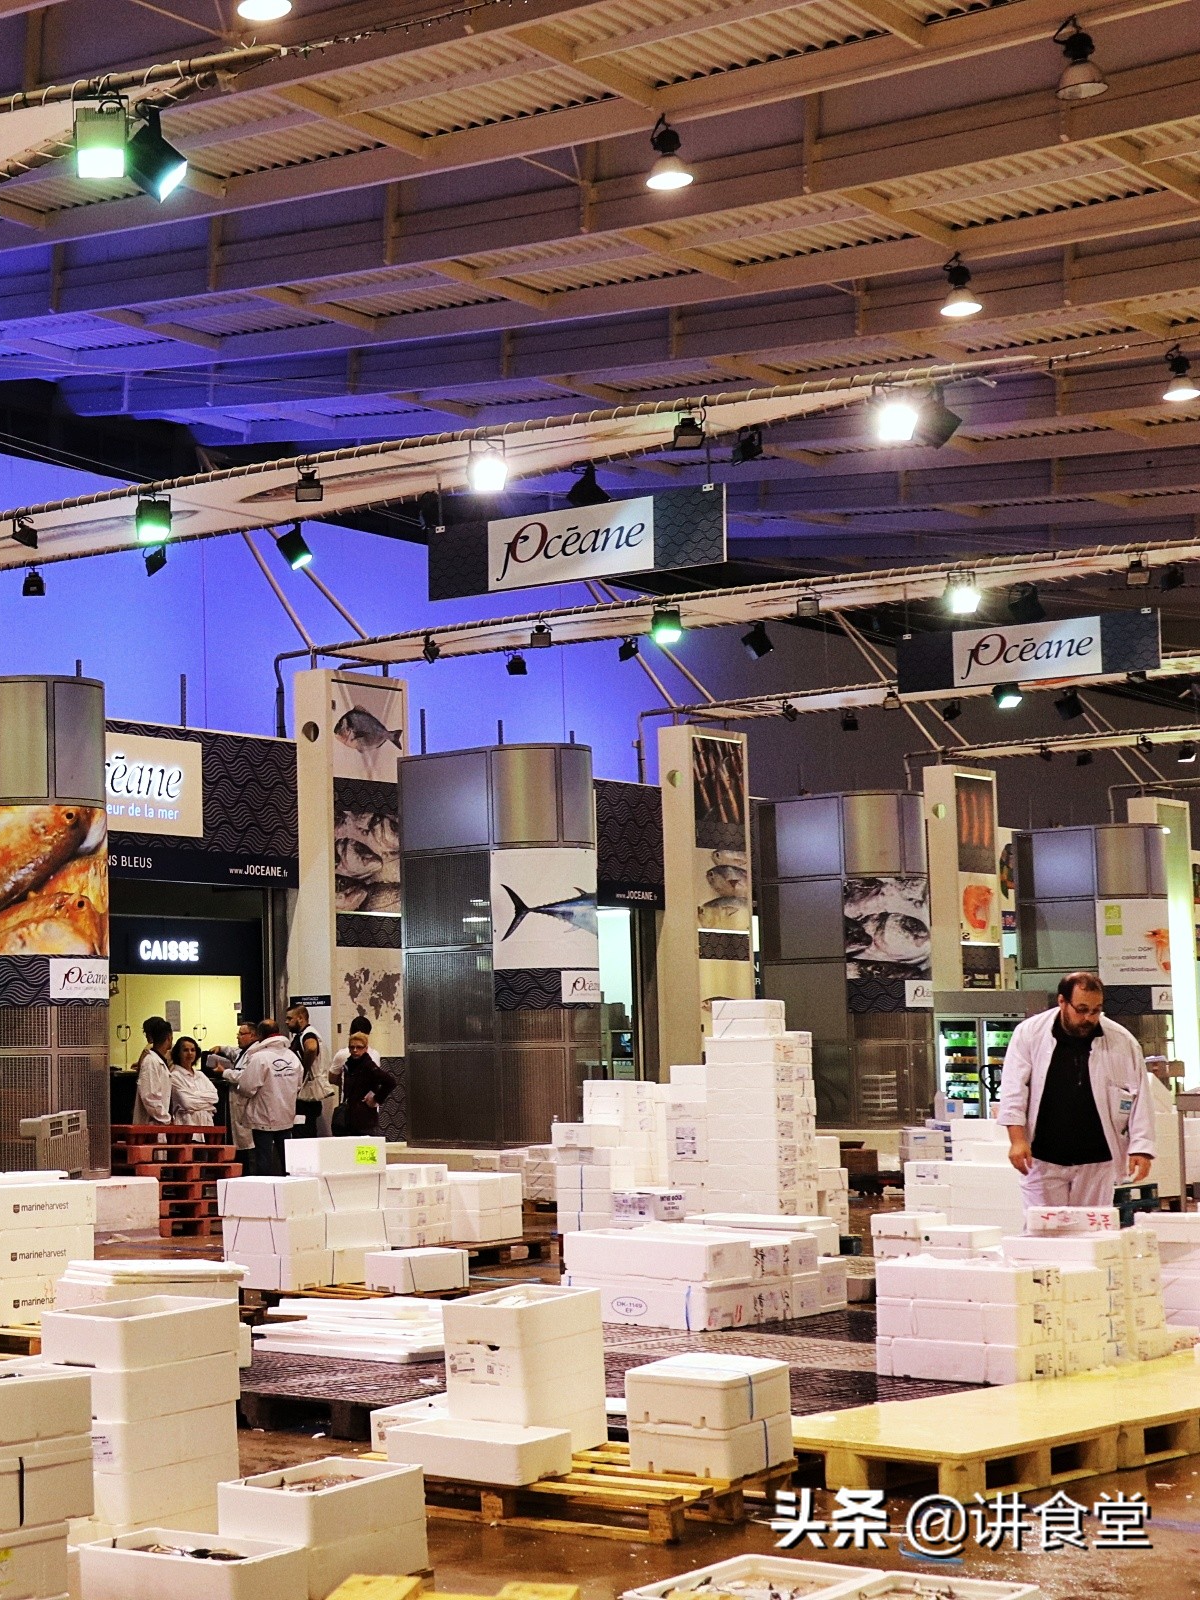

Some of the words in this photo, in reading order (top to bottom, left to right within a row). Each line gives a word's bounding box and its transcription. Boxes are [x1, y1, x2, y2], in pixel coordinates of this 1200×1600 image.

[128, 804, 141, 817] de
[145, 804, 154, 818] la
[157, 808, 179, 820] mer
[121, 856, 153, 869] BLEUS
[229, 865, 288, 878] www.JOCEANE.fr
[140, 940, 199, 961] CAISSE
